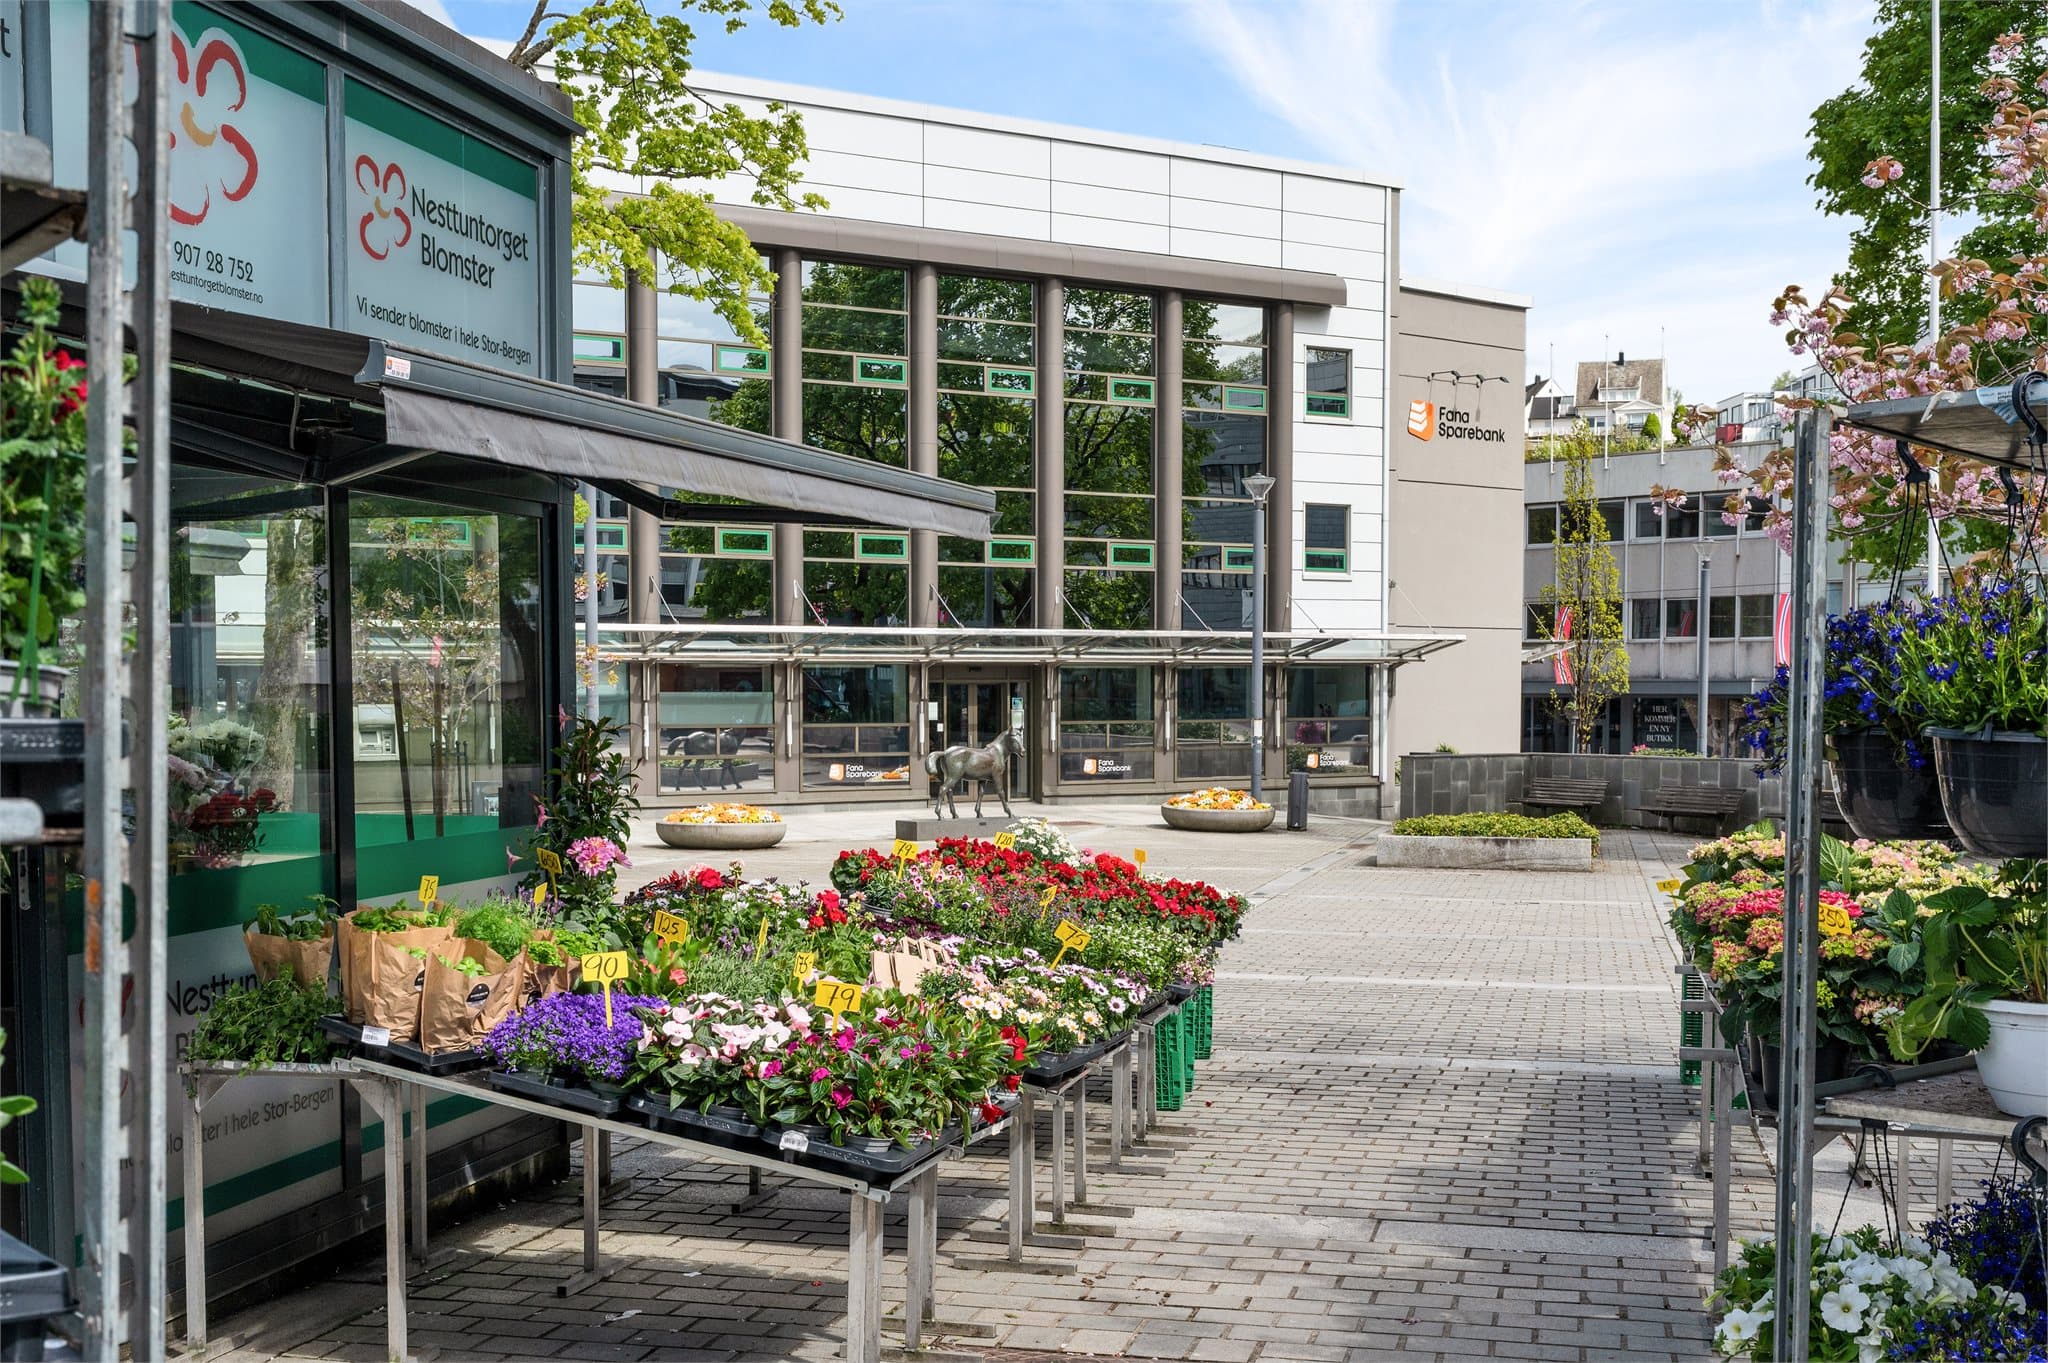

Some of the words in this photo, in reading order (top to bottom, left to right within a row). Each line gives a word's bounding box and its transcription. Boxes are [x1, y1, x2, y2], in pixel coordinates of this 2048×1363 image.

[411, 184, 529, 262] Nesttuntorget
[174, 240, 201, 267] 907
[206, 250, 224, 274] 28
[228, 256, 254, 283] 752
[421, 233, 496, 289] Blomster
[169, 270, 264, 304] esttuntorgetblomster.no
[356, 294, 368, 315] Vi
[370, 304, 407, 327] sender
[409, 311, 453, 342] blomster
[454, 325, 458, 343] i
[460, 327, 479, 350] hele
[481, 334, 532, 366] Stor-Bergen
[1439, 406, 1470, 424] Fana
[1438, 422, 1506, 443] Sparebank
[1644, 714, 1676, 723] KOMMER
[1653, 705, 1668, 713] HER
[1647, 734, 1673, 742] BUTIKK
[845, 764, 864, 772] Fana
[996, 832, 1012, 846] 120
[423, 878, 435, 900] 75
[1065, 924, 1088, 946] 75
[584, 955, 618, 979] 90
[821, 983, 855, 1010] 79
[224, 1113, 229, 1136] i
[232, 1108, 260, 1134] hele
[263, 1086, 334, 1123] Stor-Bergen
